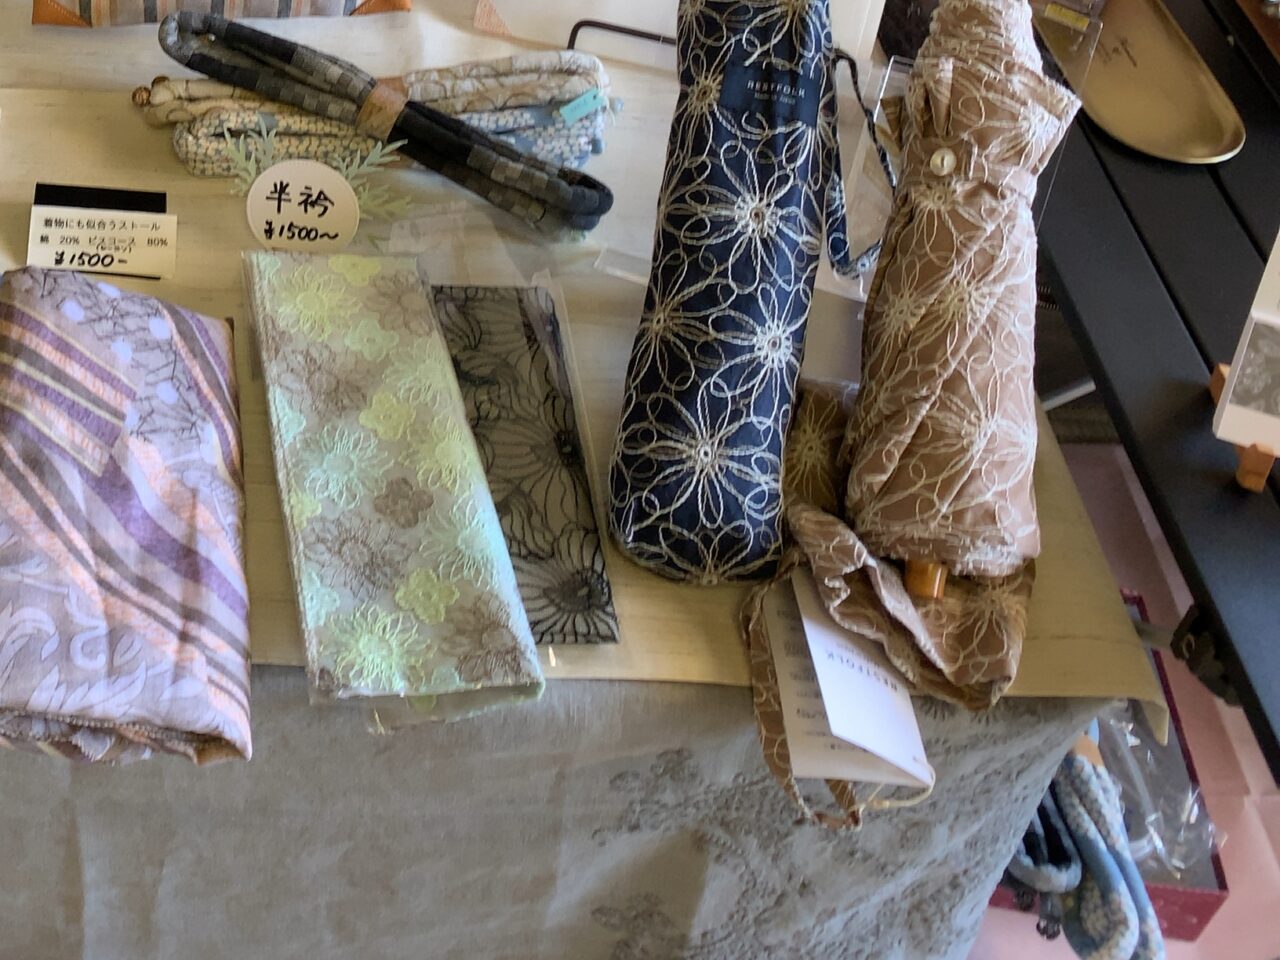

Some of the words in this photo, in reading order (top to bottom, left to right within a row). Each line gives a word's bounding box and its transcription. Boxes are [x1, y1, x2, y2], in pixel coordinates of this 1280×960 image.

[43, 216, 161, 232] 着物にも似合うストール
[59, 235, 80, 246] 20%
[88, 235, 136, 247] ビスコース
